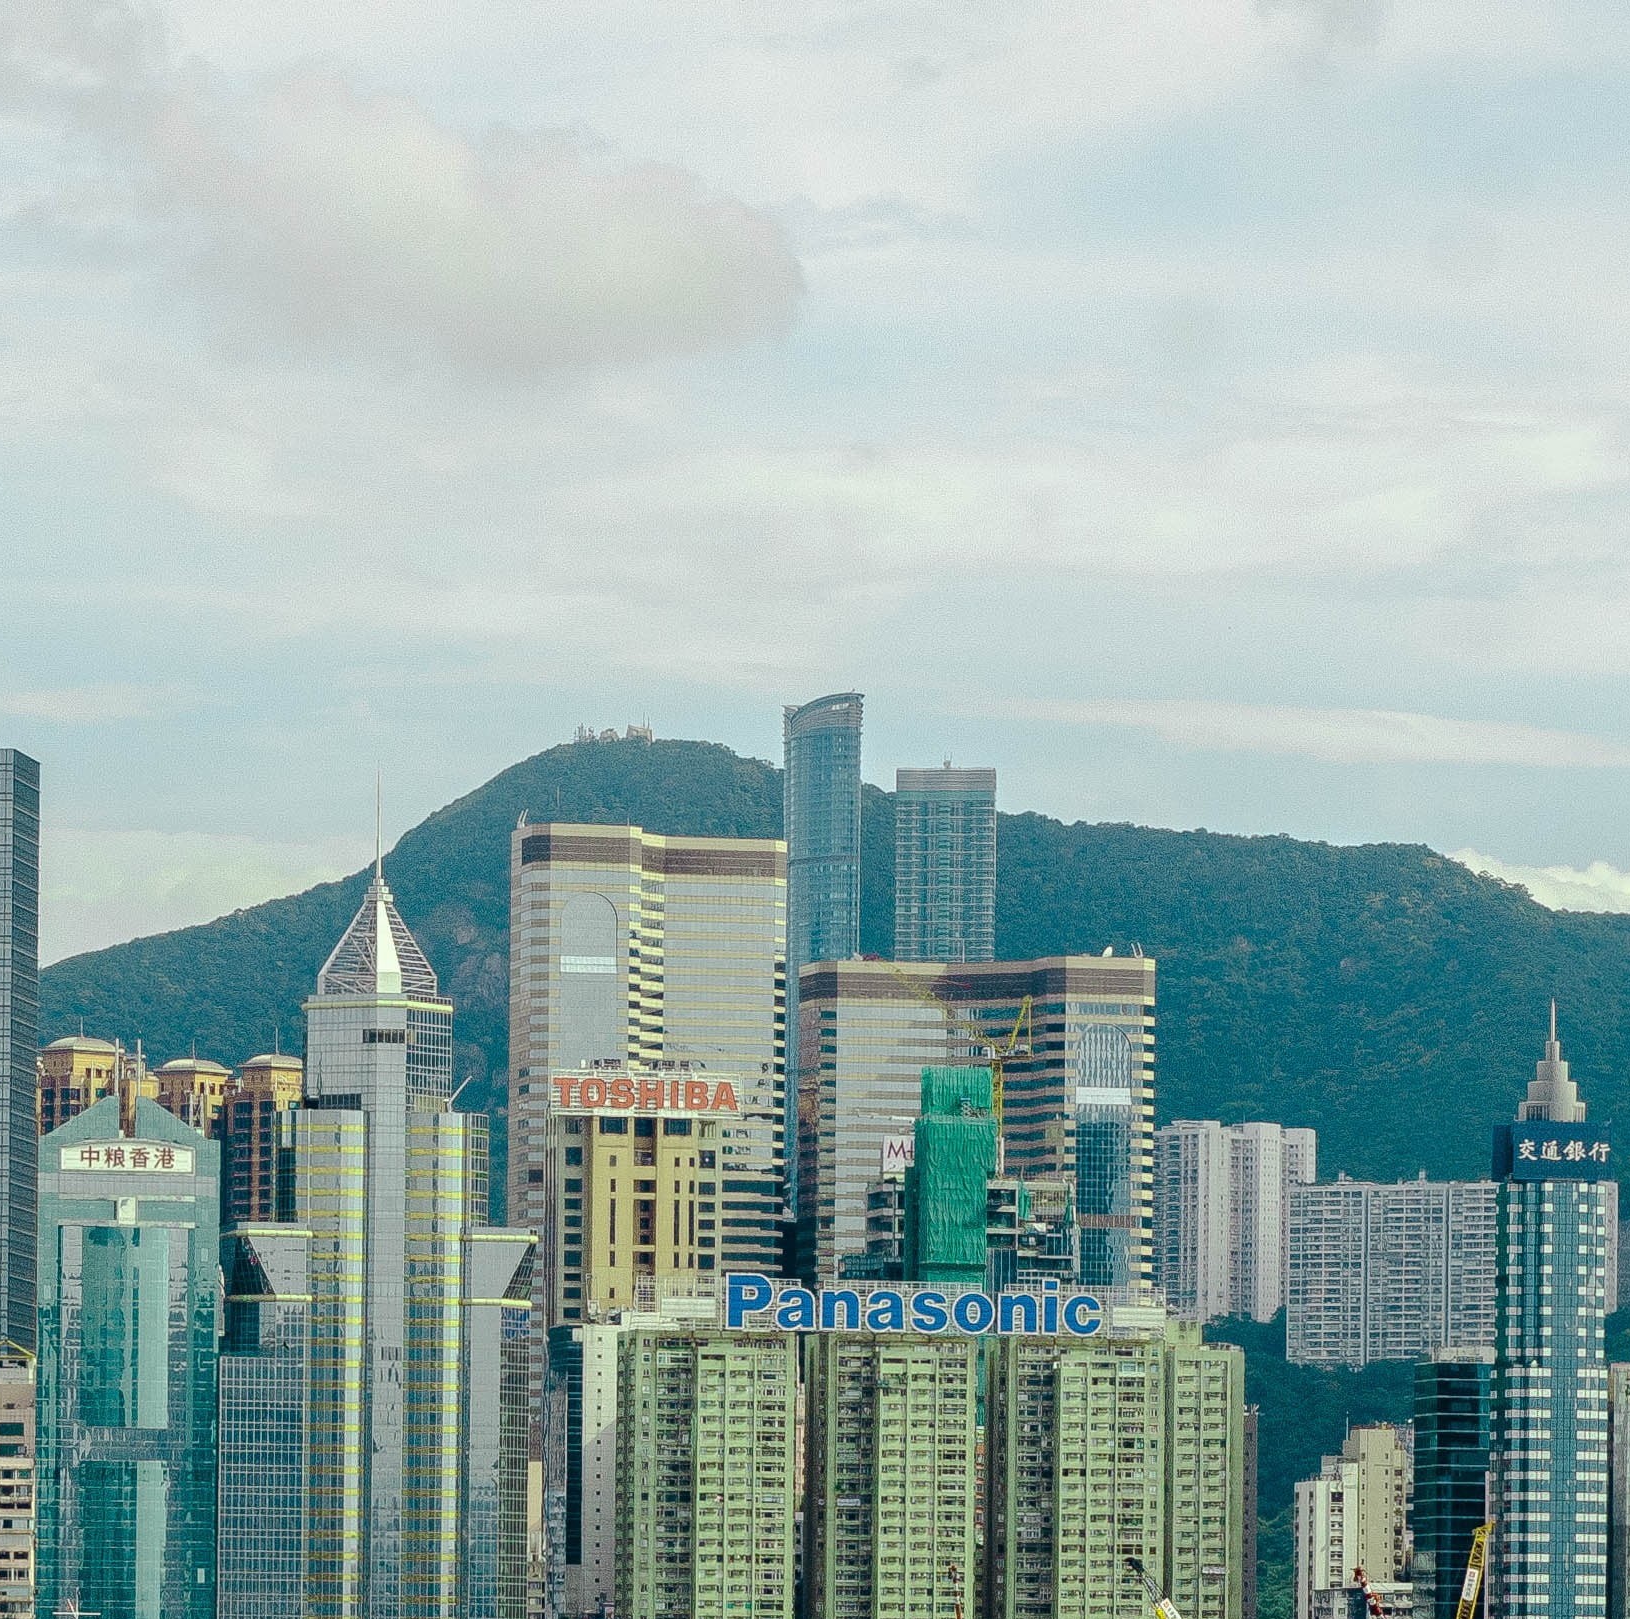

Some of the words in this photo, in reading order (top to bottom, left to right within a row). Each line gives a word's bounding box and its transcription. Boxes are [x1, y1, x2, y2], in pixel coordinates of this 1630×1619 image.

[552, 1076, 739, 1112] TOSHIBA
[79, 1145, 176, 1170] 中粮香港
[1517, 1138, 1612, 1163] 交通銀行
[724, 1271, 1104, 1337] Panasonic
